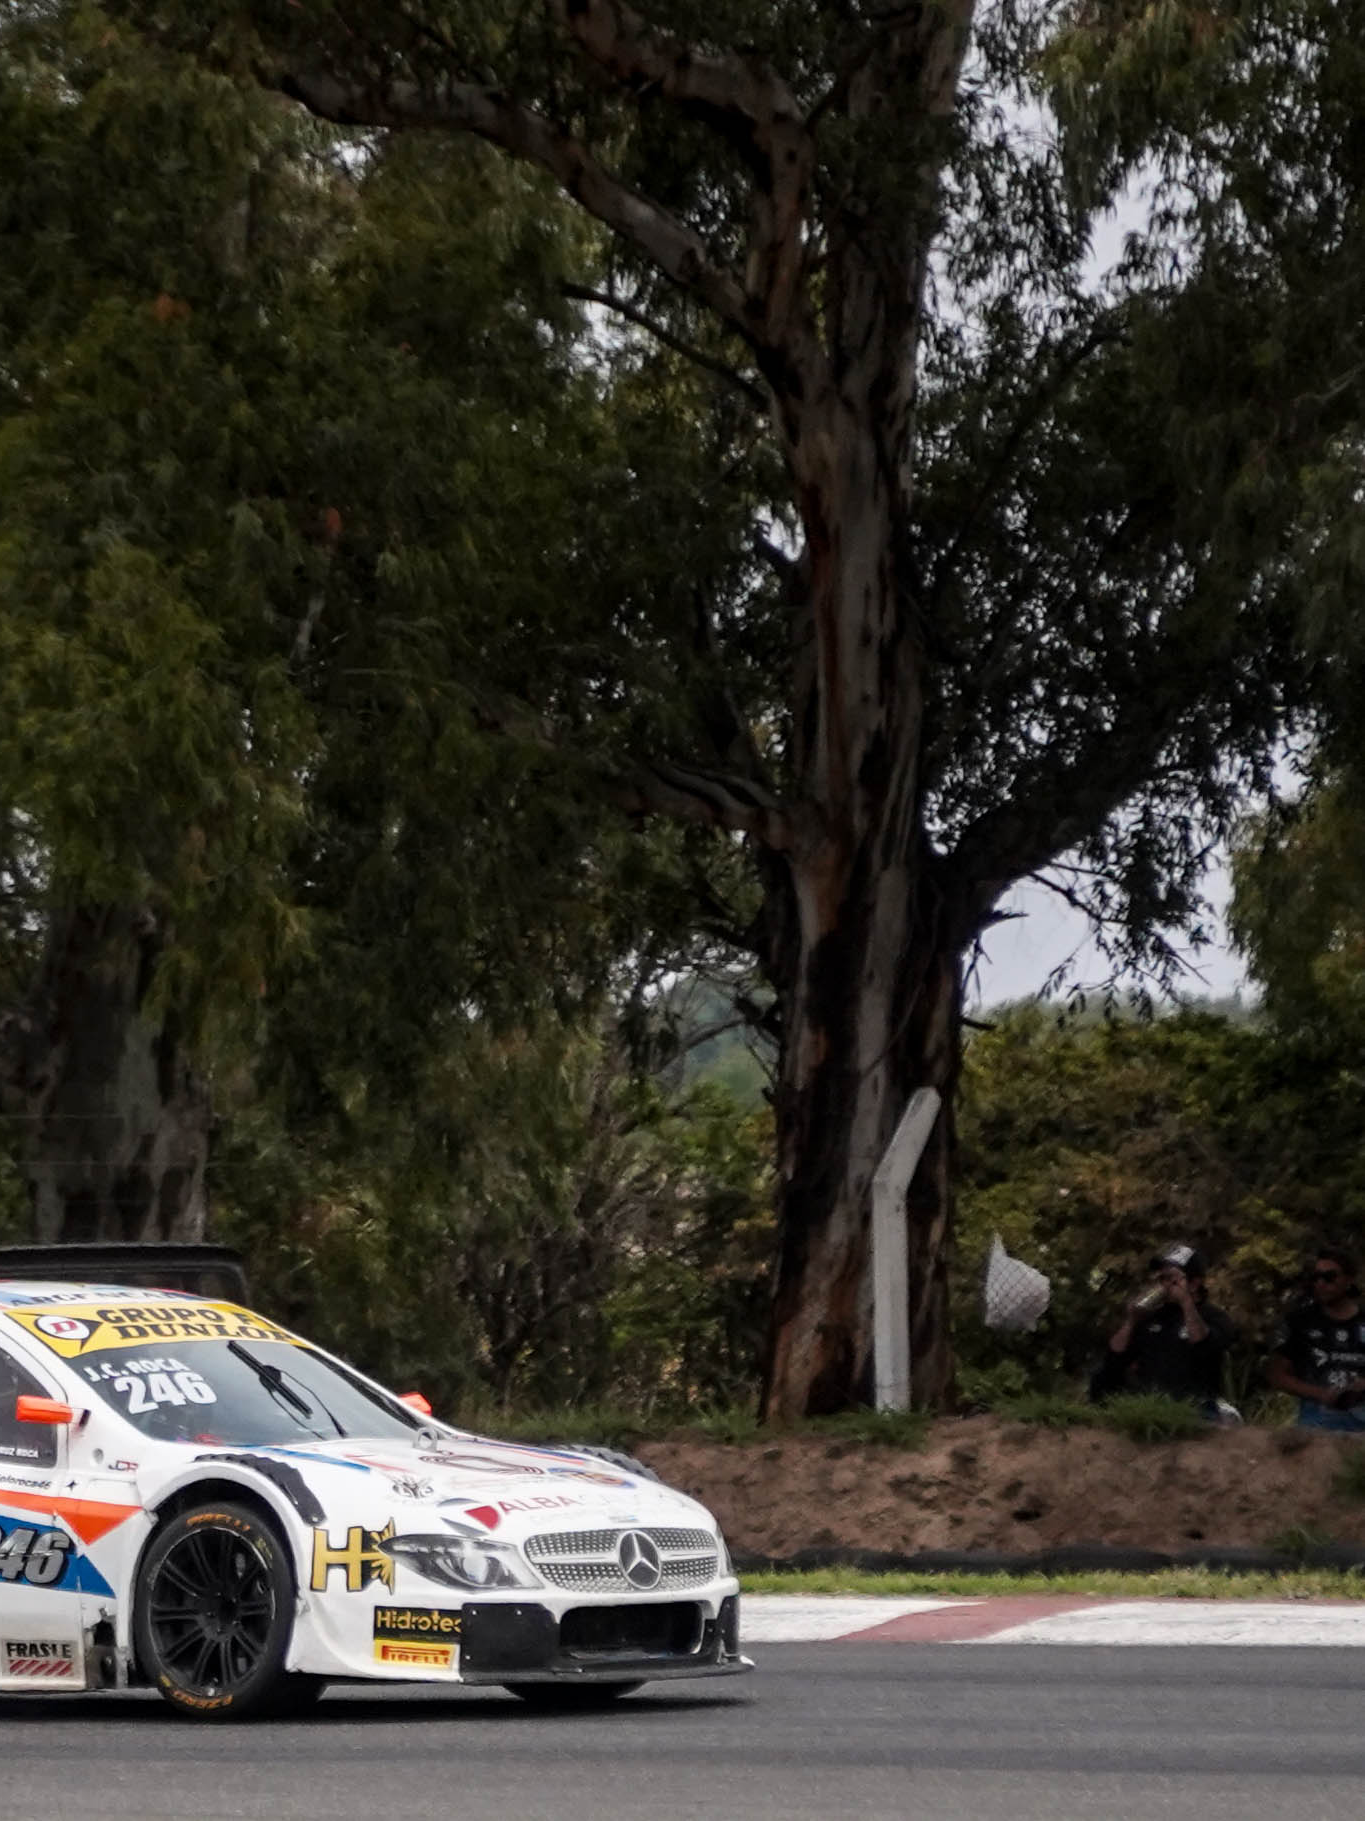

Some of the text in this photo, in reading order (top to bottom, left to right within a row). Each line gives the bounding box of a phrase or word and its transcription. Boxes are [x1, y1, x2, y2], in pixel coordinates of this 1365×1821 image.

[96, 1307, 222, 1325] GRUPO
[125, 1357, 191, 1375] ROCA
[113, 1371, 218, 1415] 246
[16, 1448, 39, 1458] ROCA
[381, 1645, 450, 1666] PIRELLI
